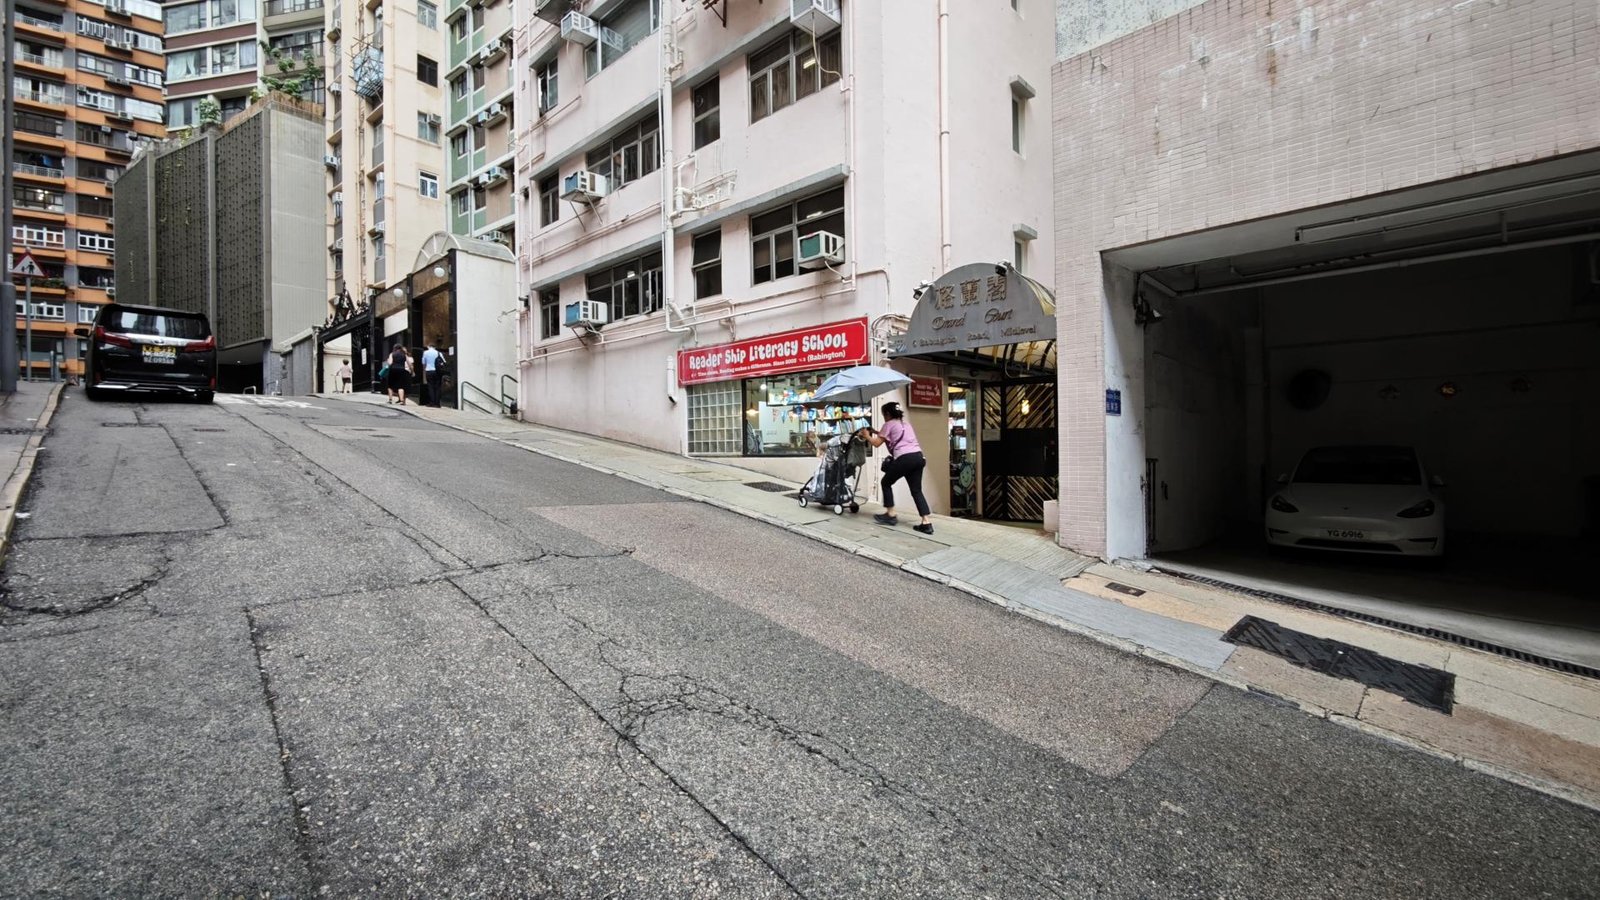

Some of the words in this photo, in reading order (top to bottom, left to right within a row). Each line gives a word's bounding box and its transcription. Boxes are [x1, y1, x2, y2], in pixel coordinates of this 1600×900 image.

[689, 352, 722, 370] Reader
[725, 348, 746, 365] Ship
[749, 339, 799, 362] Literacy
[807, 349, 846, 362] (Babington)
[1341, 530, 1364, 539] 6916
